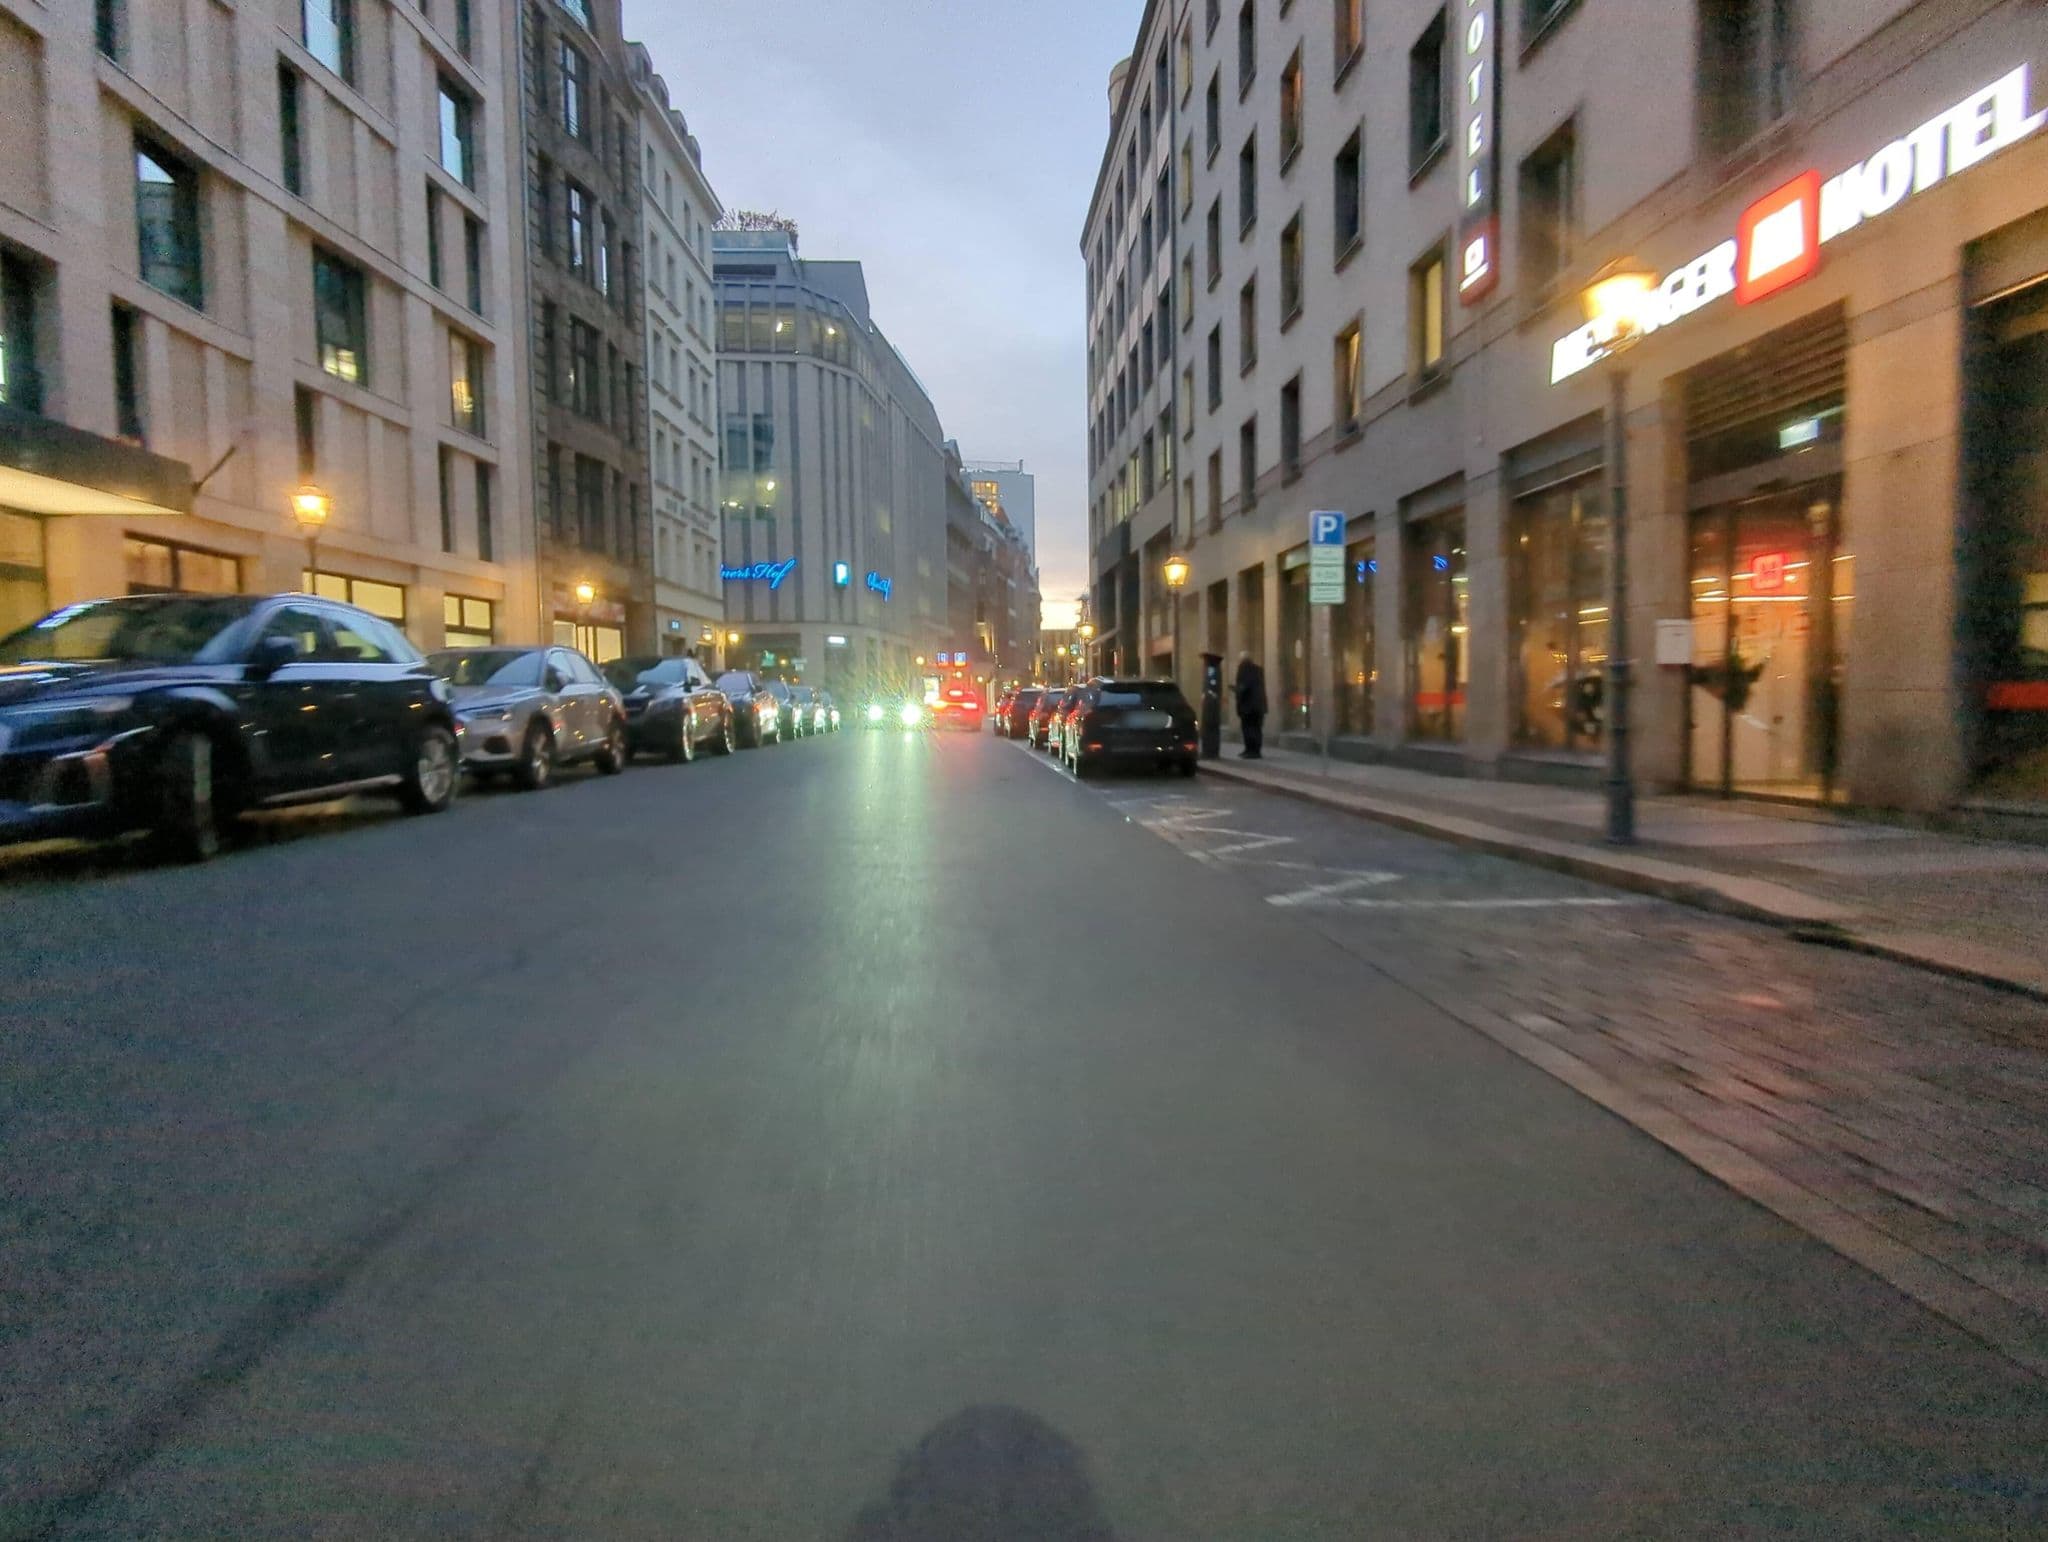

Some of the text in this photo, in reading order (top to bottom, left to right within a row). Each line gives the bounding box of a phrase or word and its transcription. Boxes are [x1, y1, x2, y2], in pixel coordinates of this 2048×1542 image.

[1466, 0, 1485, 208] OTEL
[1551, 62, 2048, 384] MEGER HOTEL
[1316, 514, 1338, 542] P
